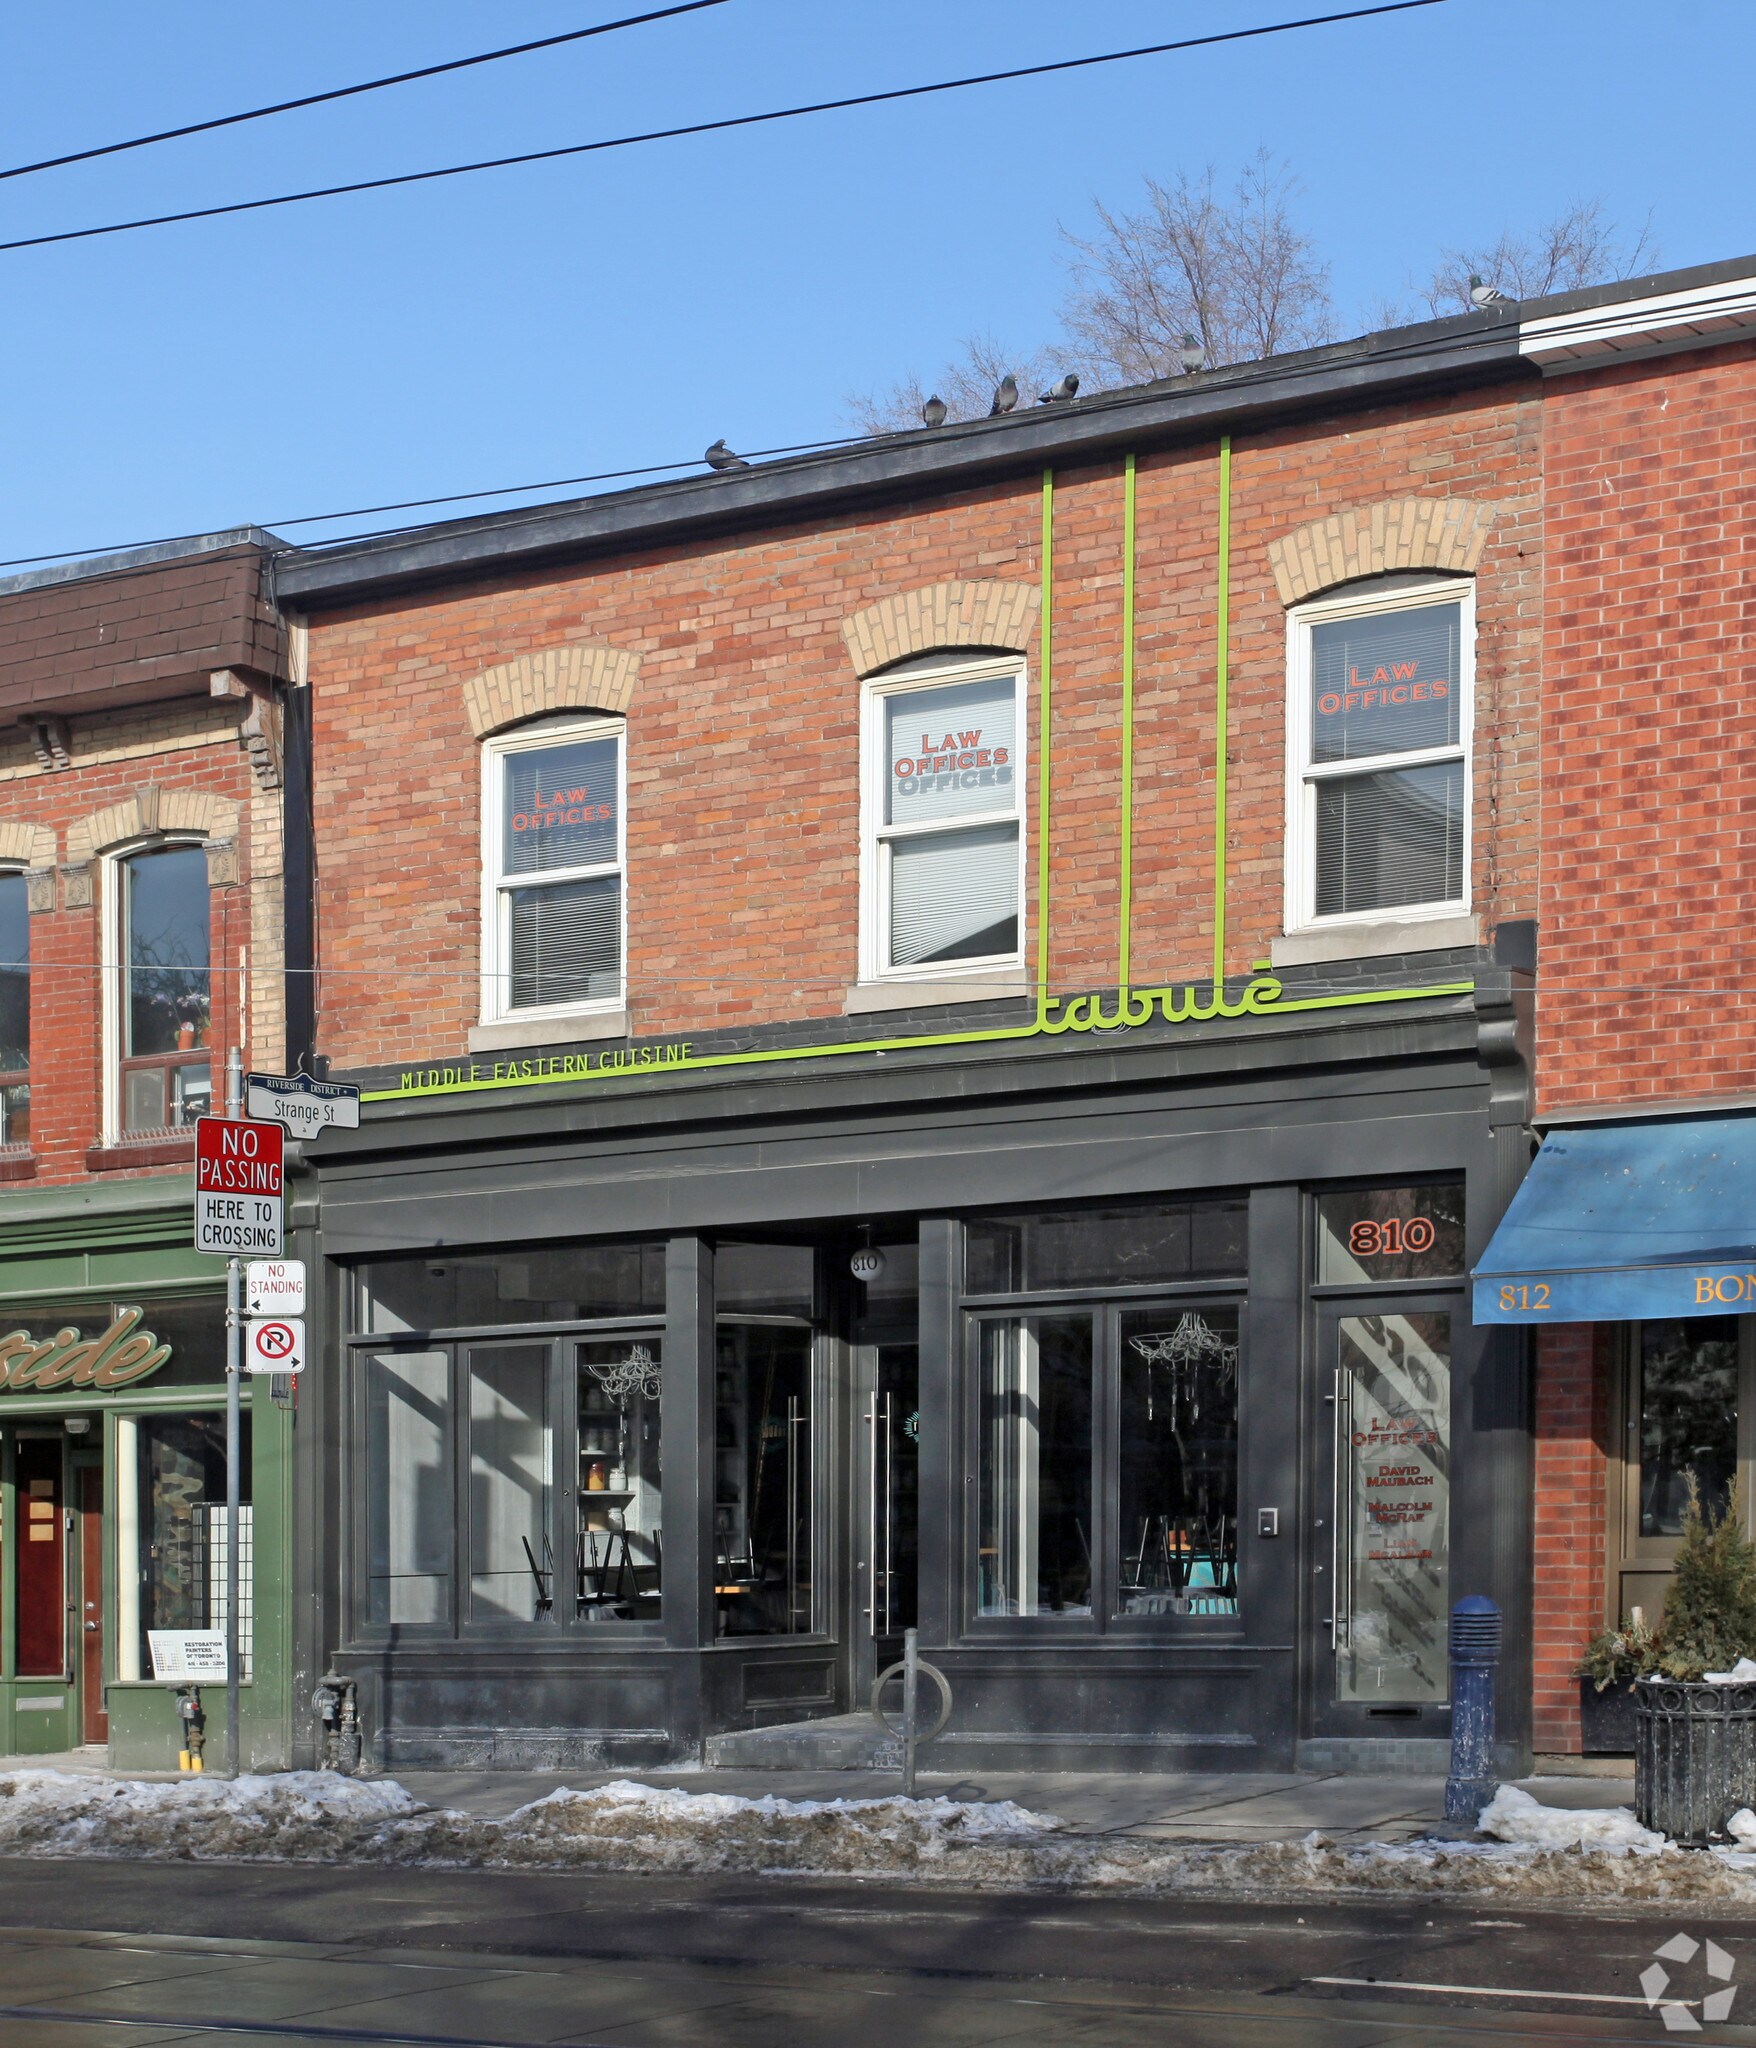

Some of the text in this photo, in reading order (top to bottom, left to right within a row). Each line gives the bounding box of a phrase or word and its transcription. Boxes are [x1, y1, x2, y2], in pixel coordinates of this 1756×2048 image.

[1350, 661, 1418, 688] LAW
[1318, 681, 1449, 714] OFFICES
[921, 729, 982, 754] LAW
[894, 747, 1009, 778] OFFICES
[535, 786, 588, 810] LAW
[511, 804, 612, 831] OFFICES
[401, 1042, 693, 1090] MIDDLE EASTERN CUISINE
[266, 1079, 341, 1096] RIVERSIDE DISTRICT
[274, 1099, 335, 1122] Strange St
[222, 1127, 259, 1157] NO
[200, 1157, 280, 1191] PASSING
[207, 1199, 272, 1222] HERE TO
[203, 1224, 276, 1248] CROSSING
[1349, 1217, 1435, 1255] 810
[268, 1264, 285, 1278] NO
[853, 1256, 878, 1271] 810
[250, 1280, 302, 1294] STANDING
[1499, 1283, 1551, 1310] 812
[1372, 1417, 1416, 1431] LAW
[1351, 1432, 1438, 1447] OFFICES
[1366, 1476, 1434, 1487] MAUBACH
[1379, 1465, 1421, 1476] DAVID
[1368, 1502, 1433, 1513] MALCOLM
